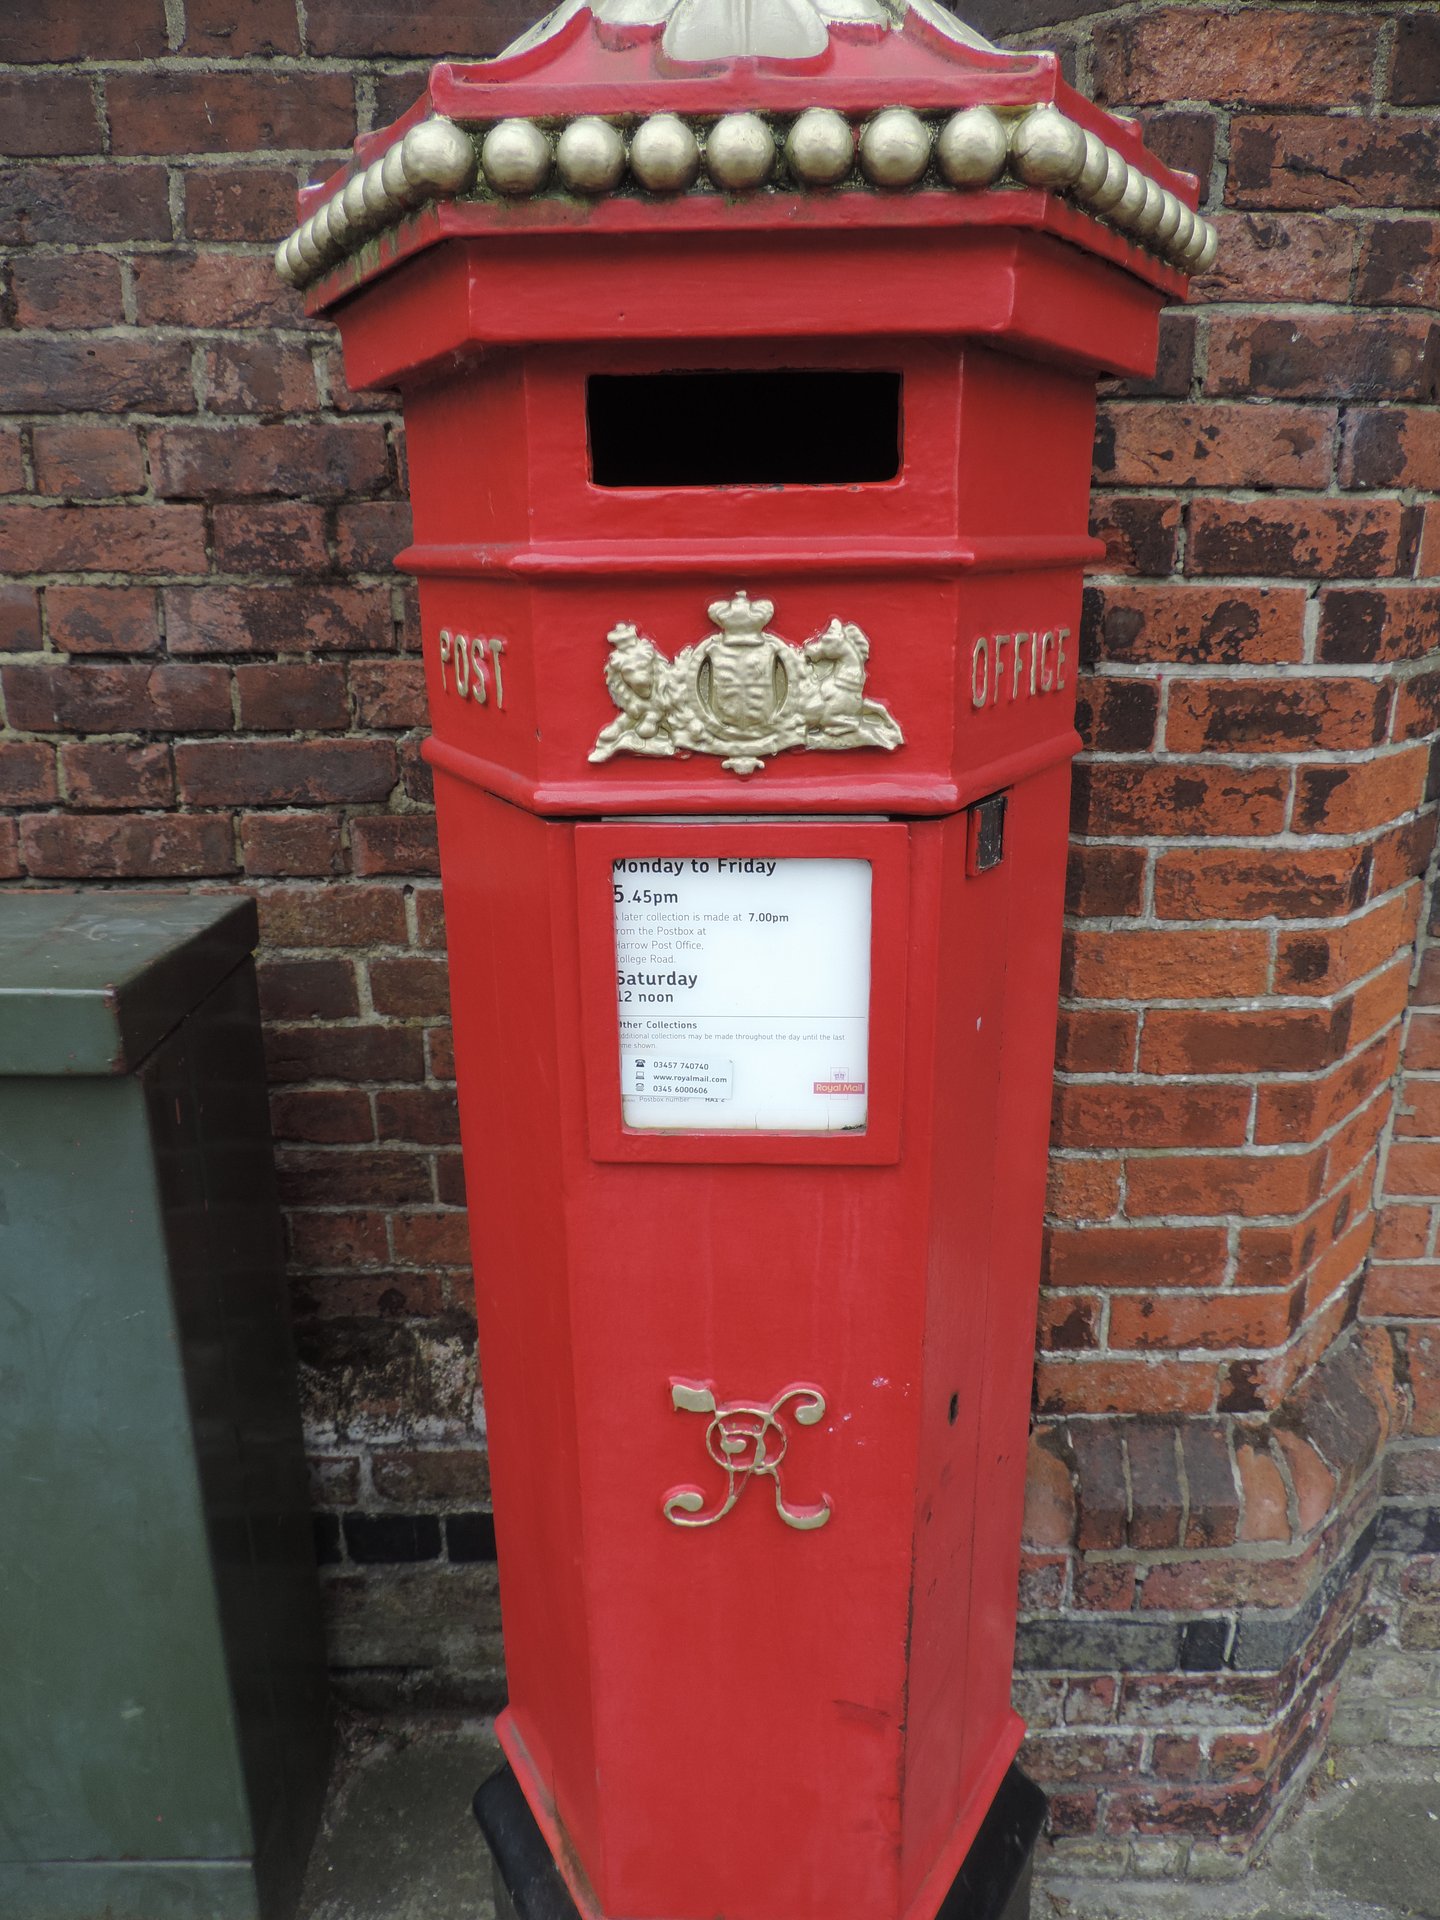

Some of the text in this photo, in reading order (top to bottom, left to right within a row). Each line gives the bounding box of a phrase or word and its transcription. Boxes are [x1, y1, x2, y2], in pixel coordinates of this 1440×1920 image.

[440, 629, 505, 709] POST
[972, 627, 1071, 708] OFFICE
[612, 858, 777, 876] Monday to Friday
[621, 912, 643, 921] later
[646, 912, 690, 922] collection
[692, 912, 701, 921] is
[703, 912, 730, 922] made
[732, 913, 743, 921] at
[748, 912, 789, 923] 7.00pm
[638, 926, 654, 936] the
[656, 926, 694, 936] Postbox
[697, 927, 707, 936] at
[651, 940, 673, 950] Post
[675, 940, 704, 951] Office,
[617, 970, 698, 989] Saturday
[638, 992, 674, 1003] noon
[646, 1020, 698, 1029] Collections
[651, 1032, 686, 1040] collections
[688, 1033, 702, 1041] may
[735, 1033, 774, 1041] throughout
[788, 1033, 801, 1041] day
[802, 1033, 818, 1041] until
[653, 1061, 709, 1070] 03457 740740
[653, 1074, 728, 1084] www.royalmail.com
[674, 1086, 709, 1094] 6000606
[815, 1084, 864, 1093] Royal Mail
